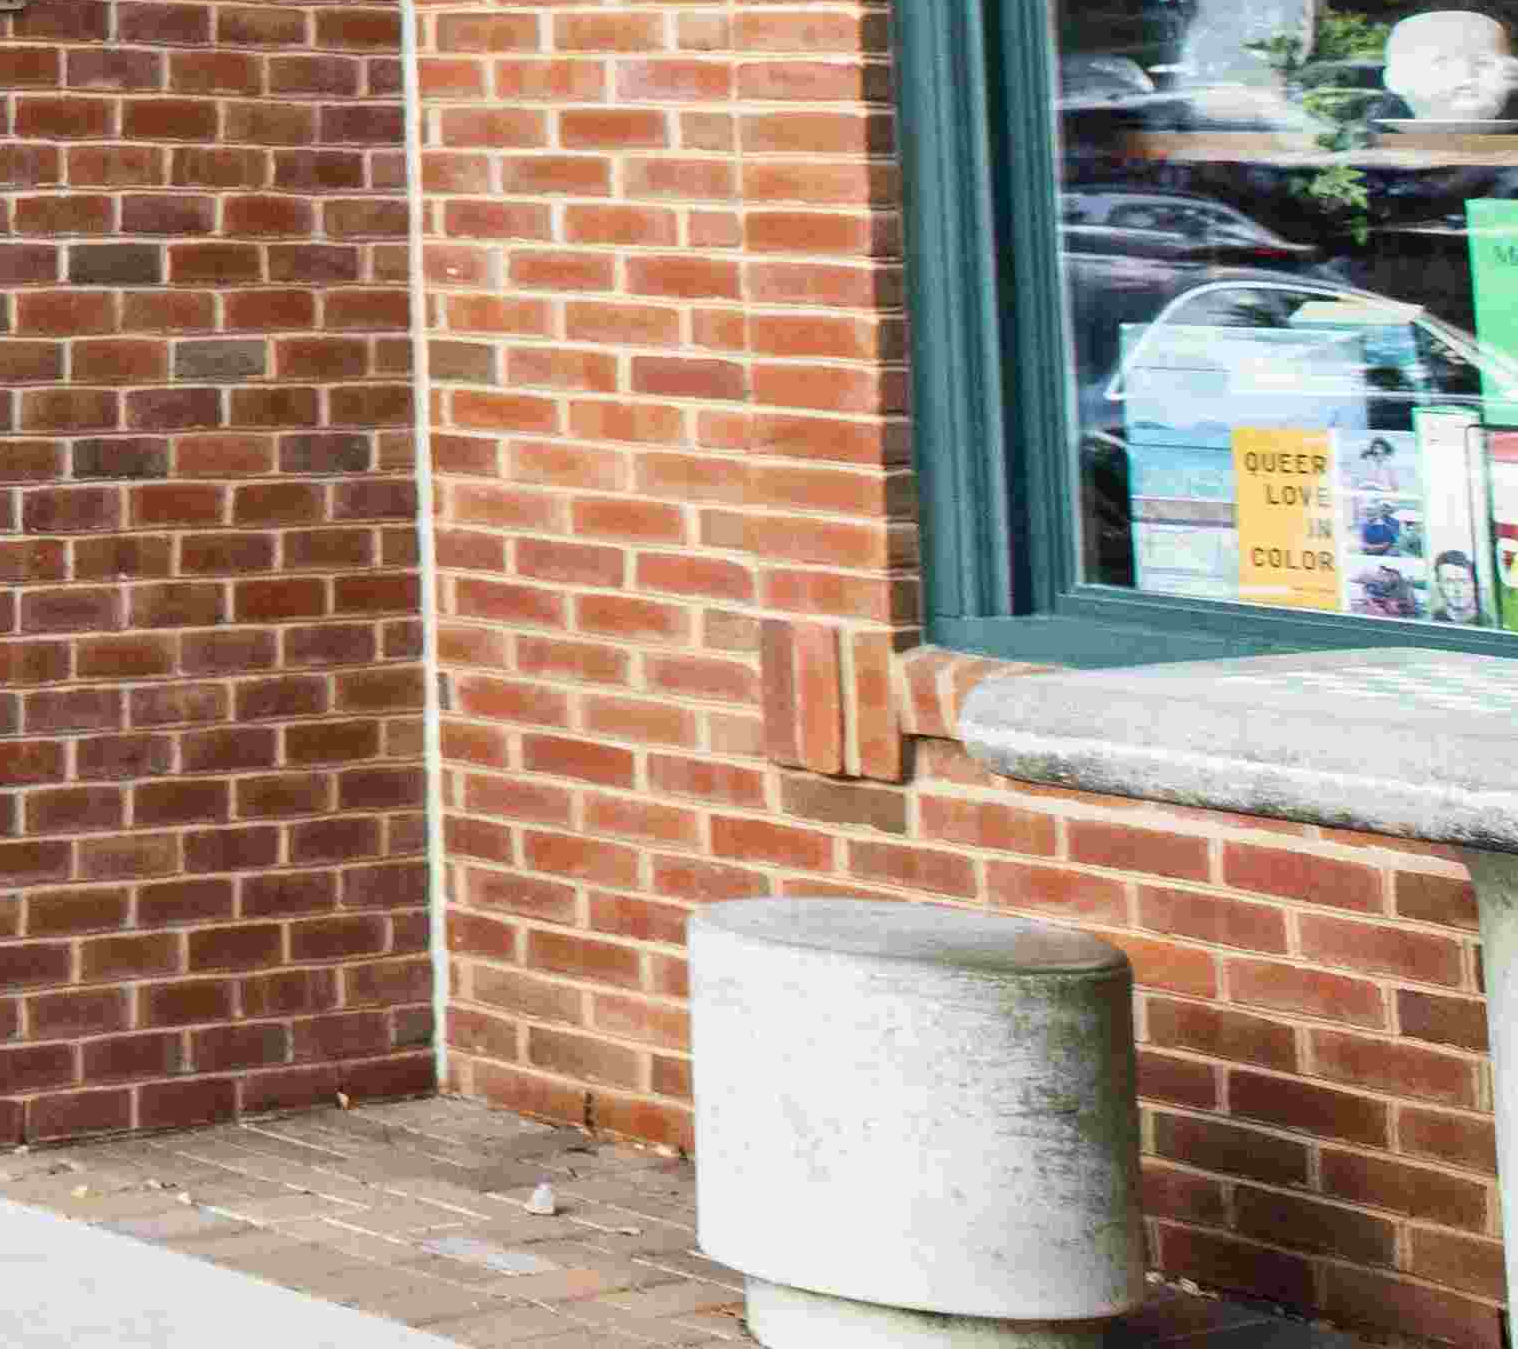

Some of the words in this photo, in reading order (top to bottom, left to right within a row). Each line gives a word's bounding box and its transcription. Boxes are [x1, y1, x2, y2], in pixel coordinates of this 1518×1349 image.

[1244, 451, 1327, 474] QUEER
[1265, 485, 1332, 508] LOVE
[1308, 518, 1333, 539] IN
[1252, 547, 1336, 571] COLOR
